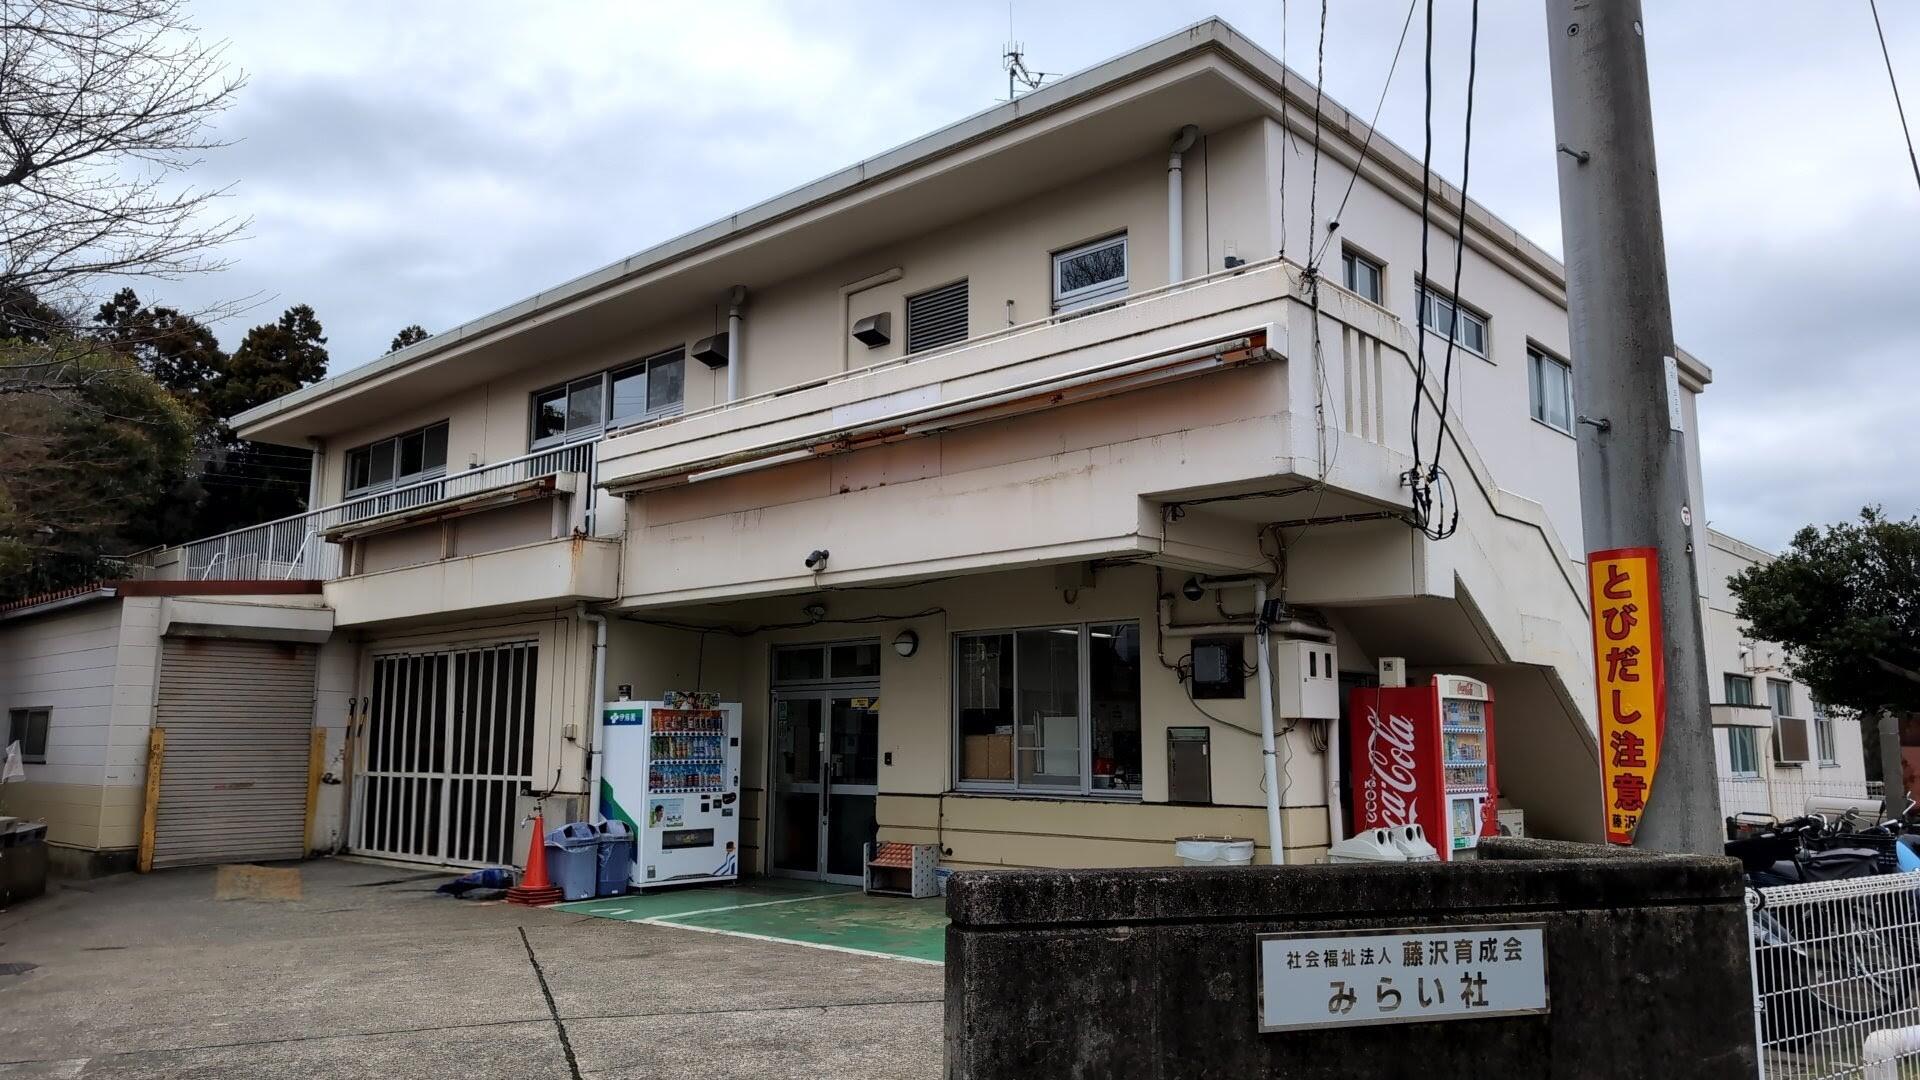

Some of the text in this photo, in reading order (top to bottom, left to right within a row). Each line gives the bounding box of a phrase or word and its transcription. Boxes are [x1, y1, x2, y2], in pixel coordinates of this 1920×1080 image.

[1602, 563, 1647, 811] とびだし注意
[1287, 936, 1523, 970] 社会福祉法人 藤沢育成会
[1327, 971, 1489, 1014] みらい社
